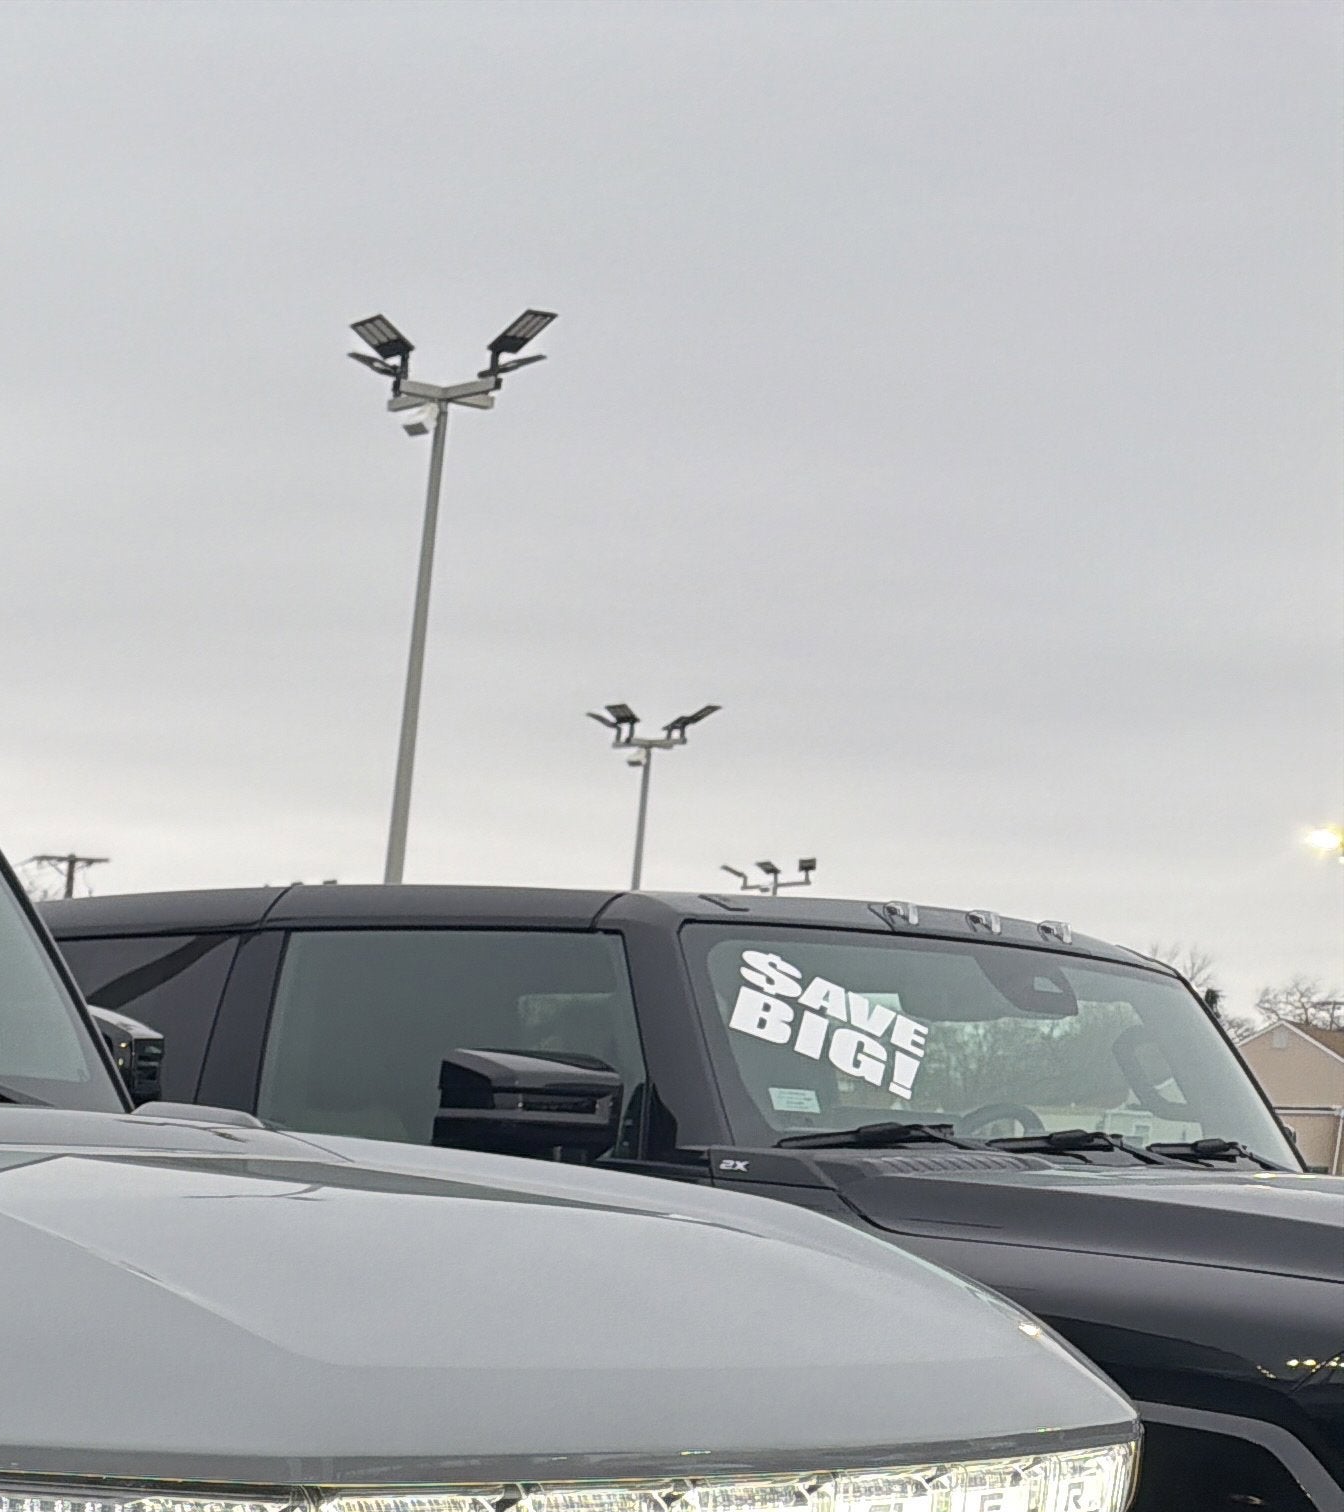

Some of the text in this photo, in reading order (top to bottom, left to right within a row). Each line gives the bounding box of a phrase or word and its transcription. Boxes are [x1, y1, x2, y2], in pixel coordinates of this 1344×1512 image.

[729, 986, 921, 1100] BIG!
[739, 950, 929, 1058] $AVE
[719, 1159, 750, 1172] 2X
